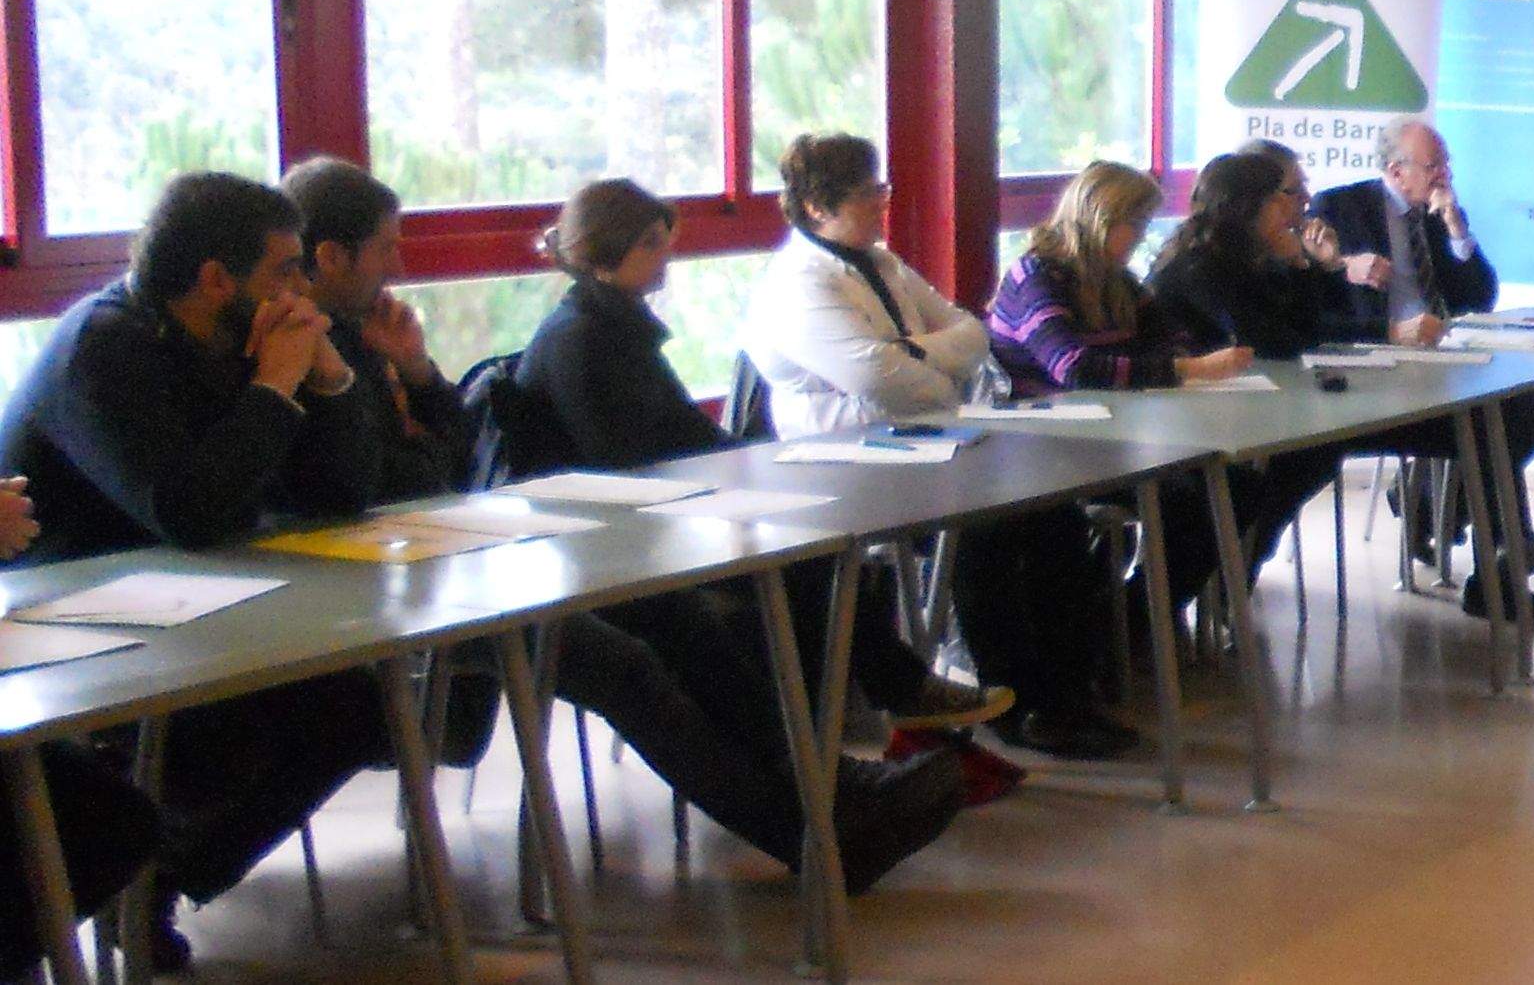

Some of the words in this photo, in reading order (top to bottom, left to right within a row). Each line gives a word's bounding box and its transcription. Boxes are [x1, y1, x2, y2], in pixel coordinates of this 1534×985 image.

[1248, 116, 1284, 137] Pla
[1293, 118, 1323, 138] de
[1333, 118, 1386, 140] Barr
